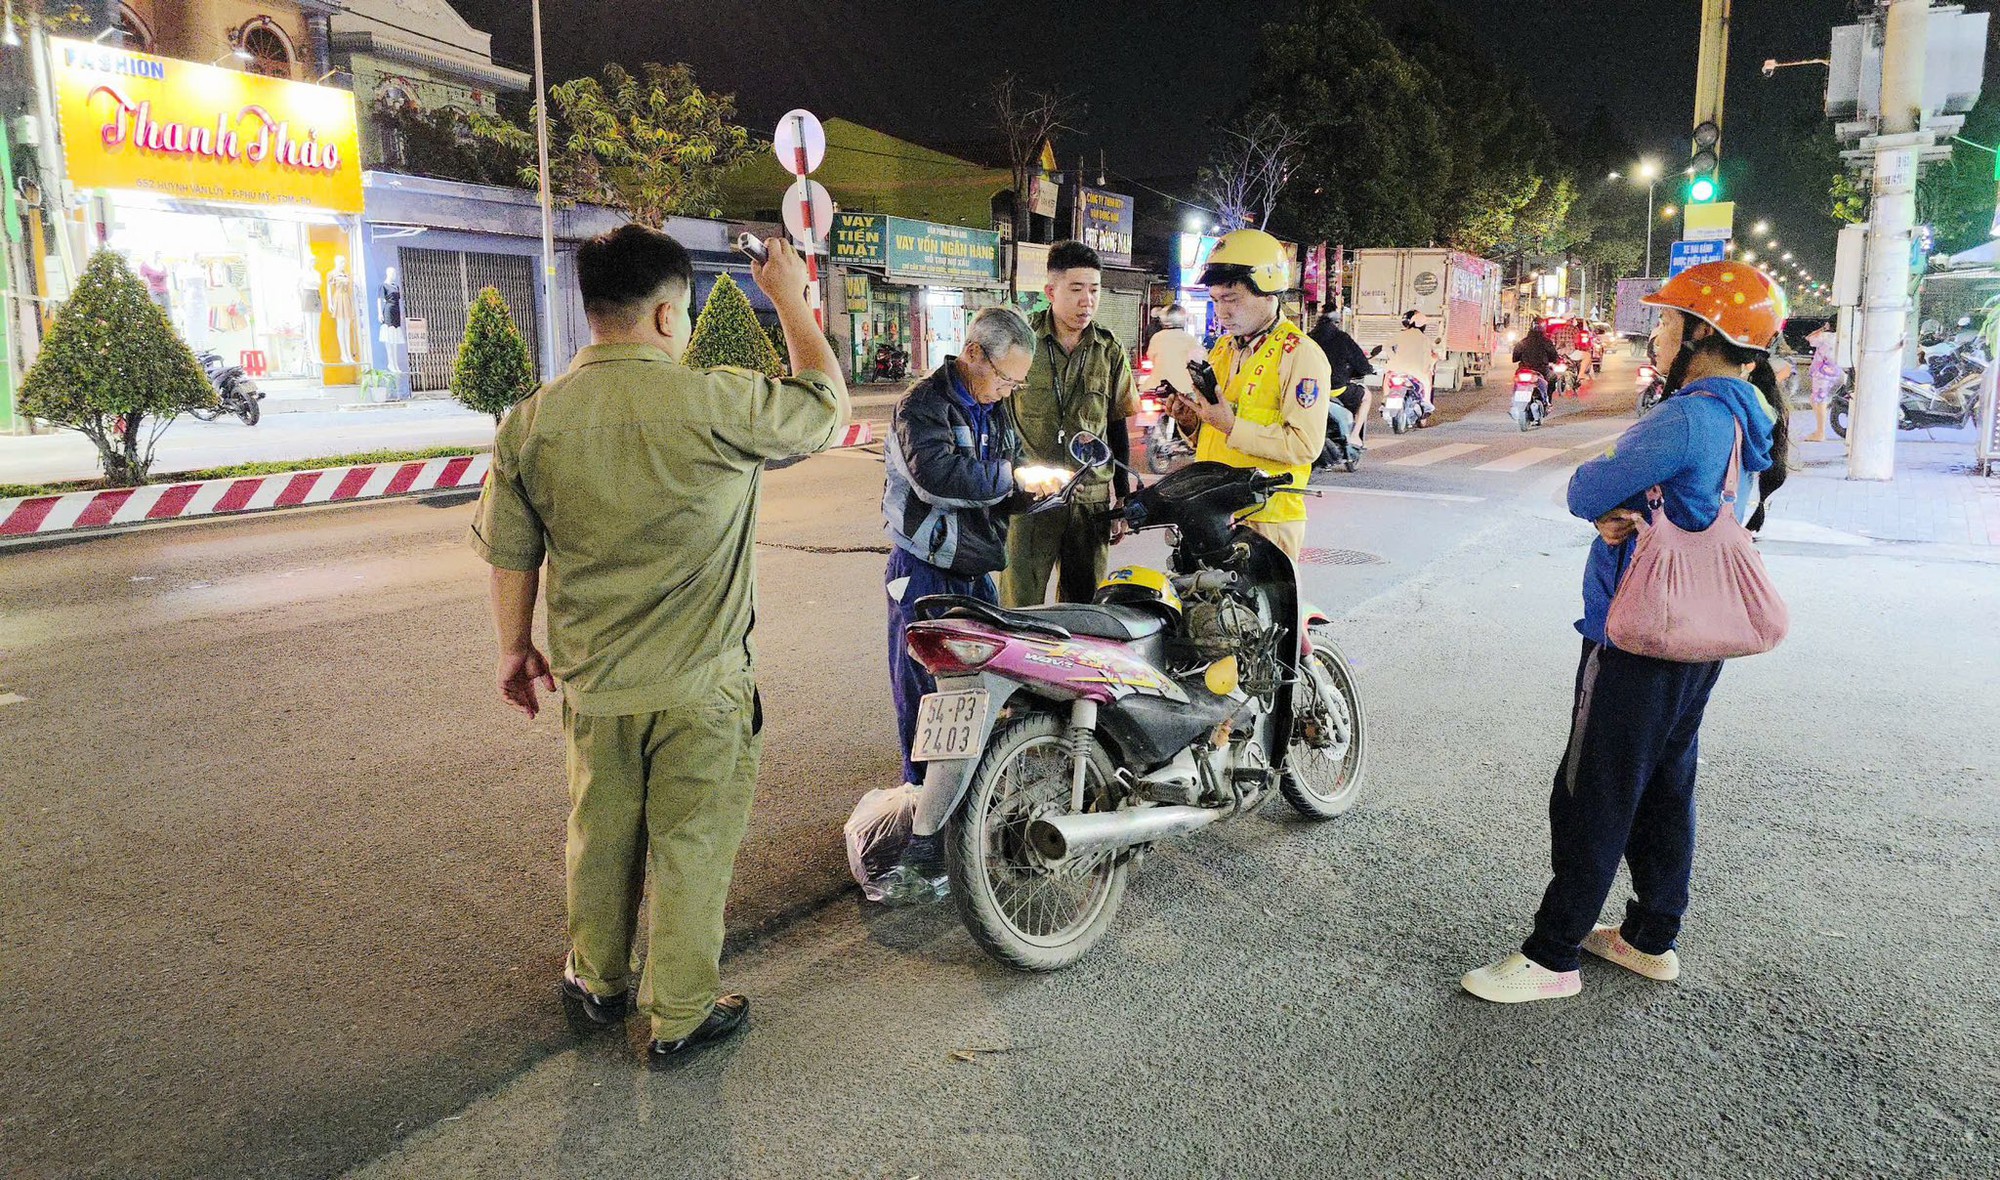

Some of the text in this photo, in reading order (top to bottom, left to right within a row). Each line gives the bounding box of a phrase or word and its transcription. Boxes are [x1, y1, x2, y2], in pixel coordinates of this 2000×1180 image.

[65, 48, 164, 80] FASHION
[87, 86, 340, 169] Thanh Thảo
[842, 216, 874, 227] VAY
[896, 234, 994, 260] VAY VỐN NGÂN HÀNG
[922, 726, 971, 754] 2403
